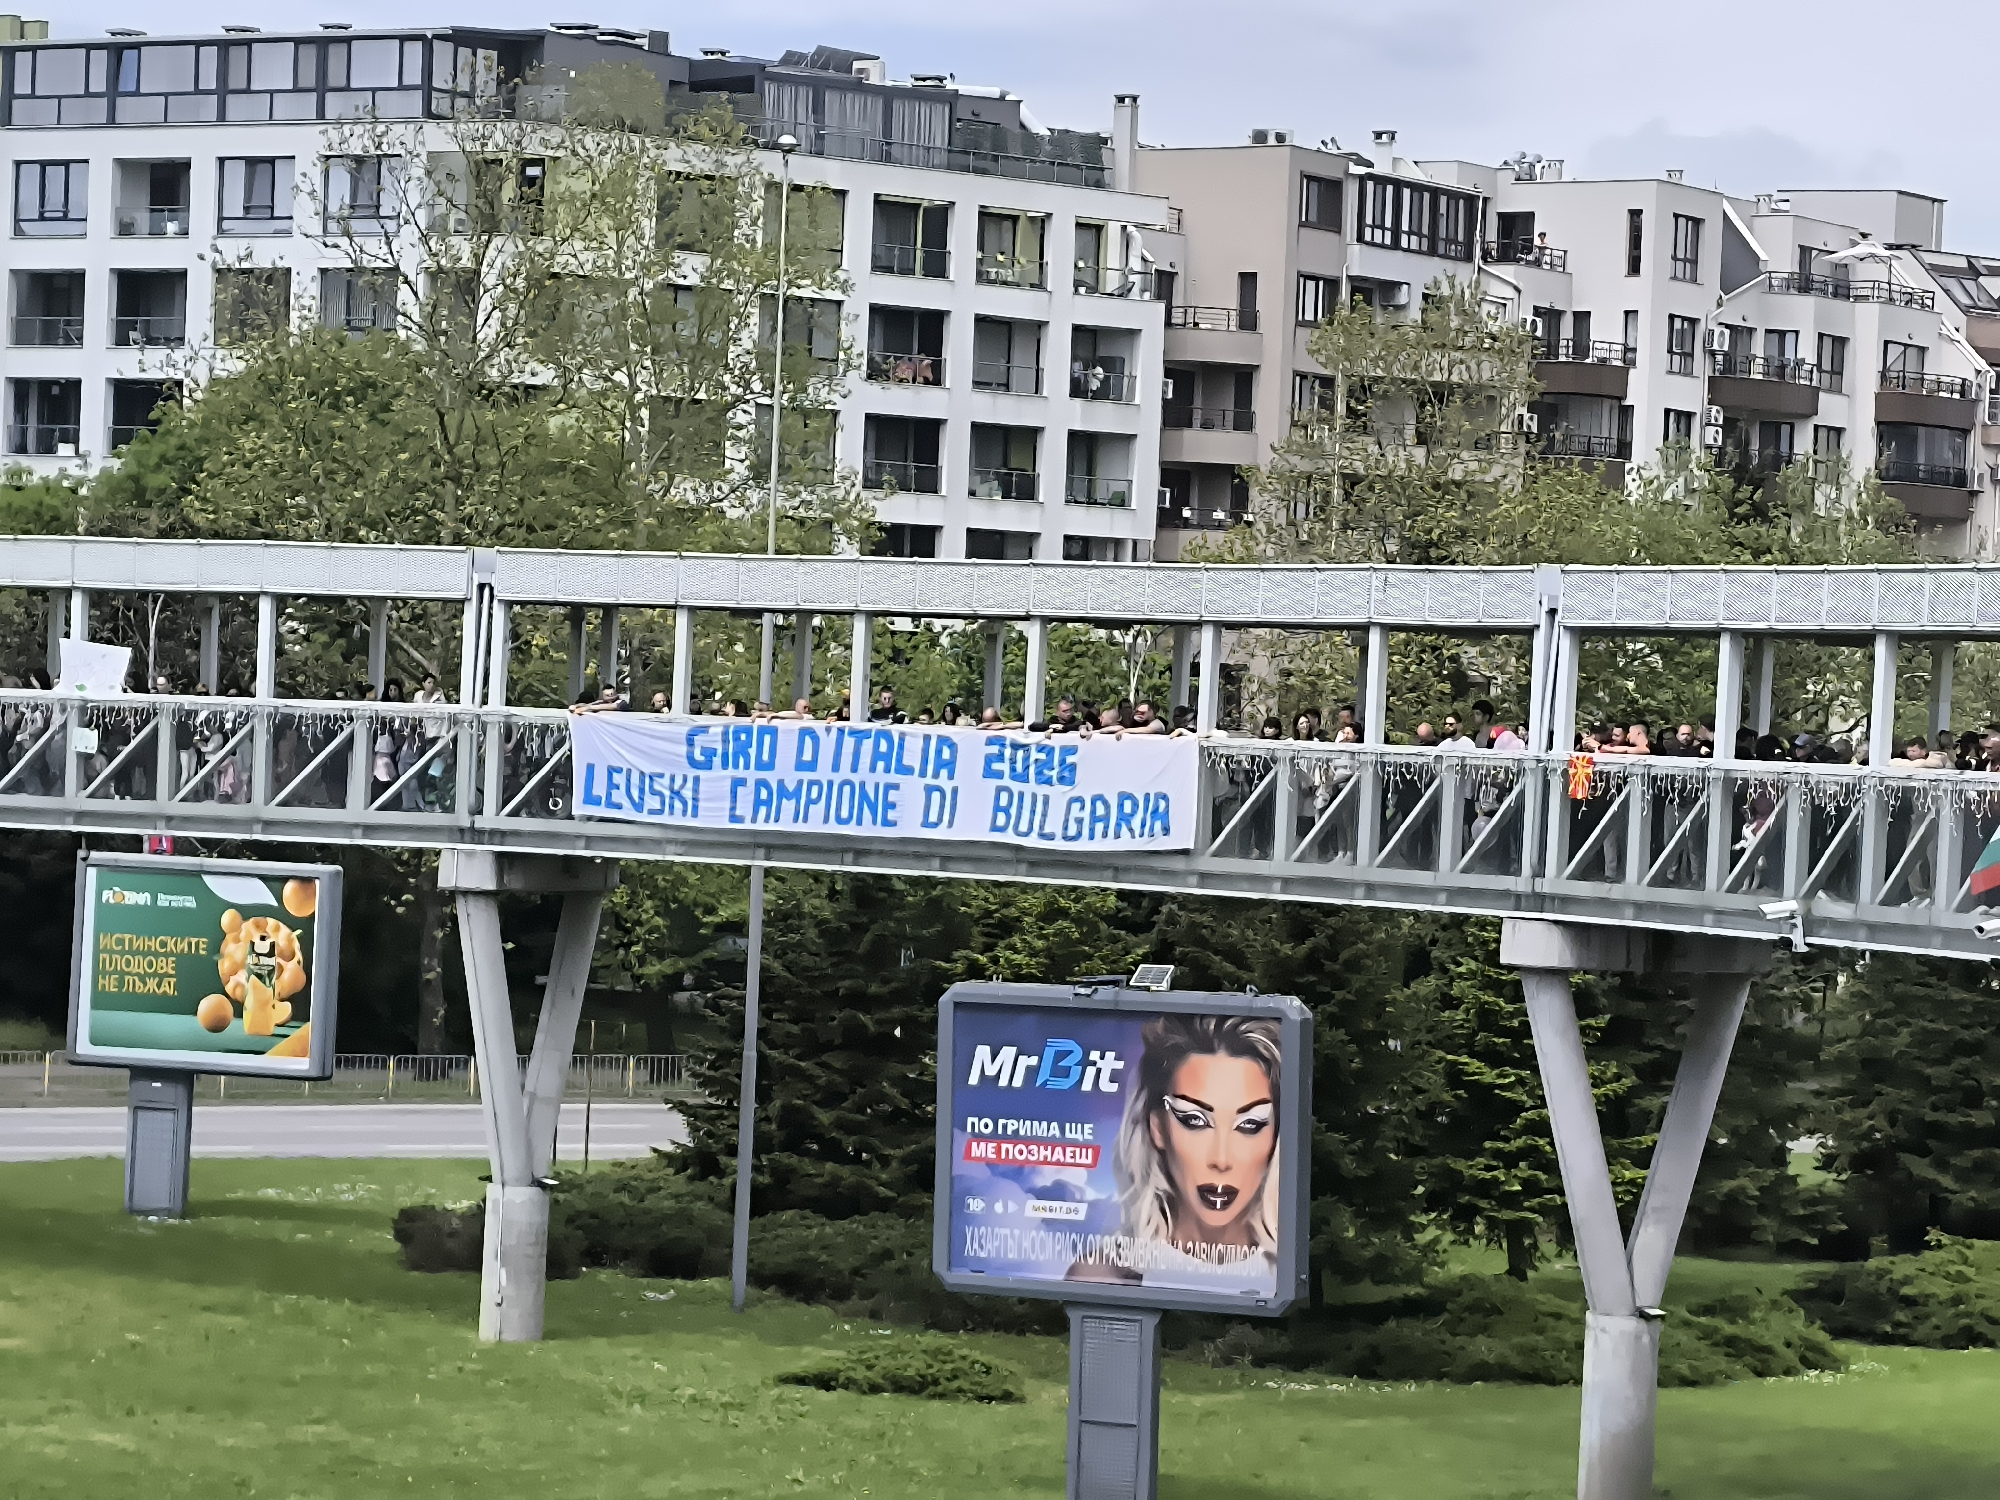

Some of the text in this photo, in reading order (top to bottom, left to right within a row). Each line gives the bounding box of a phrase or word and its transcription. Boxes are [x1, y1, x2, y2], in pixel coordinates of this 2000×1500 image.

[686, 725, 1078, 786] GIRO D'ITALIA 2026
[582, 763, 1170, 842] LEVSKI CAMPIONE DI BULGARIA
[99, 932, 208, 955] ИСТИНСКИТЕ
[99, 953, 176, 974] ПЛОДОВЕ
[98, 974, 119, 992] НЕ
[968, 1038, 1125, 1093] MrBit
[966, 1116, 1094, 1141] ПО ГРИМА ЩЕ
[971, 1141, 1093, 1164] МЕ ПОЗНАЕШ
[963, 1224, 1019, 1259] ХАЗАРТЪТ
[1021, 1228, 1053, 1261] НОСИ
[1054, 1231, 1084, 1263] РИСК
[1085, 1233, 1101, 1266] ОТ
